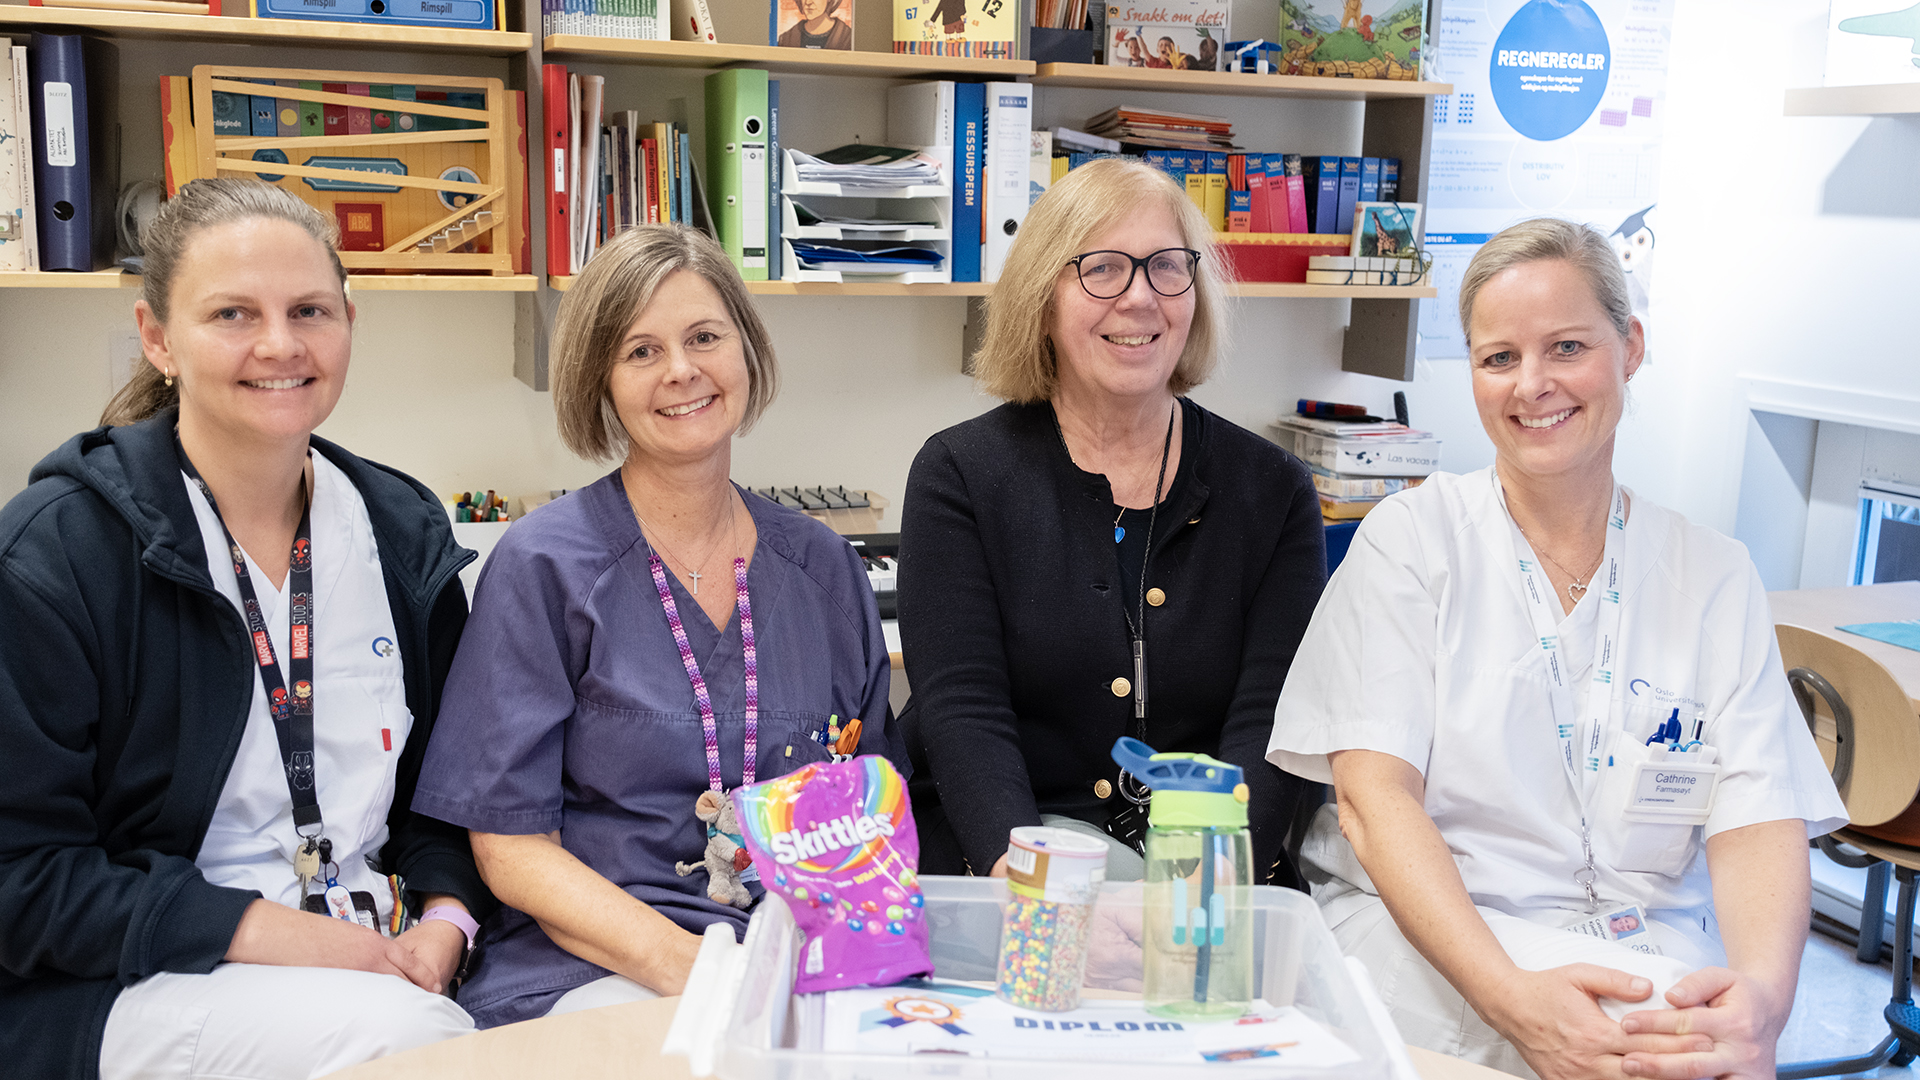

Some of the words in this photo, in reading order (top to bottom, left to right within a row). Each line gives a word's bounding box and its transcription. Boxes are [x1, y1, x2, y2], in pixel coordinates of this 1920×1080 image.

[421, 2, 452, 16] Rimspill
[905, 7, 918, 20] 67
[1123, 8, 1168, 22] Snakk
[1172, 13, 1192, 23] om
[1196, 8, 1225, 24] det!
[1498, 50, 1605, 70] REGNEREGLER
[965, 122, 976, 206] RESSURSPERM
[1522, 162, 1564, 170] DISTRIBUTIV
[351, 215, 369, 229] ABC
[1388, 453, 1402, 463] Las
[1406, 457, 1430, 465] vacas
[245, 598, 262, 632] STUDIOS
[294, 592, 306, 625] STUDIOS
[255, 632, 273, 665] MARVEL
[294, 625, 307, 658] MARVEL
[1655, 687, 1674, 696] Oslo
[1655, 773, 1697, 785] Cathrine
[1656, 786, 1691, 795] Farmasøyt
[771, 813, 895, 864] Skittles
[1014, 1016, 1185, 1031] DIPLOM
